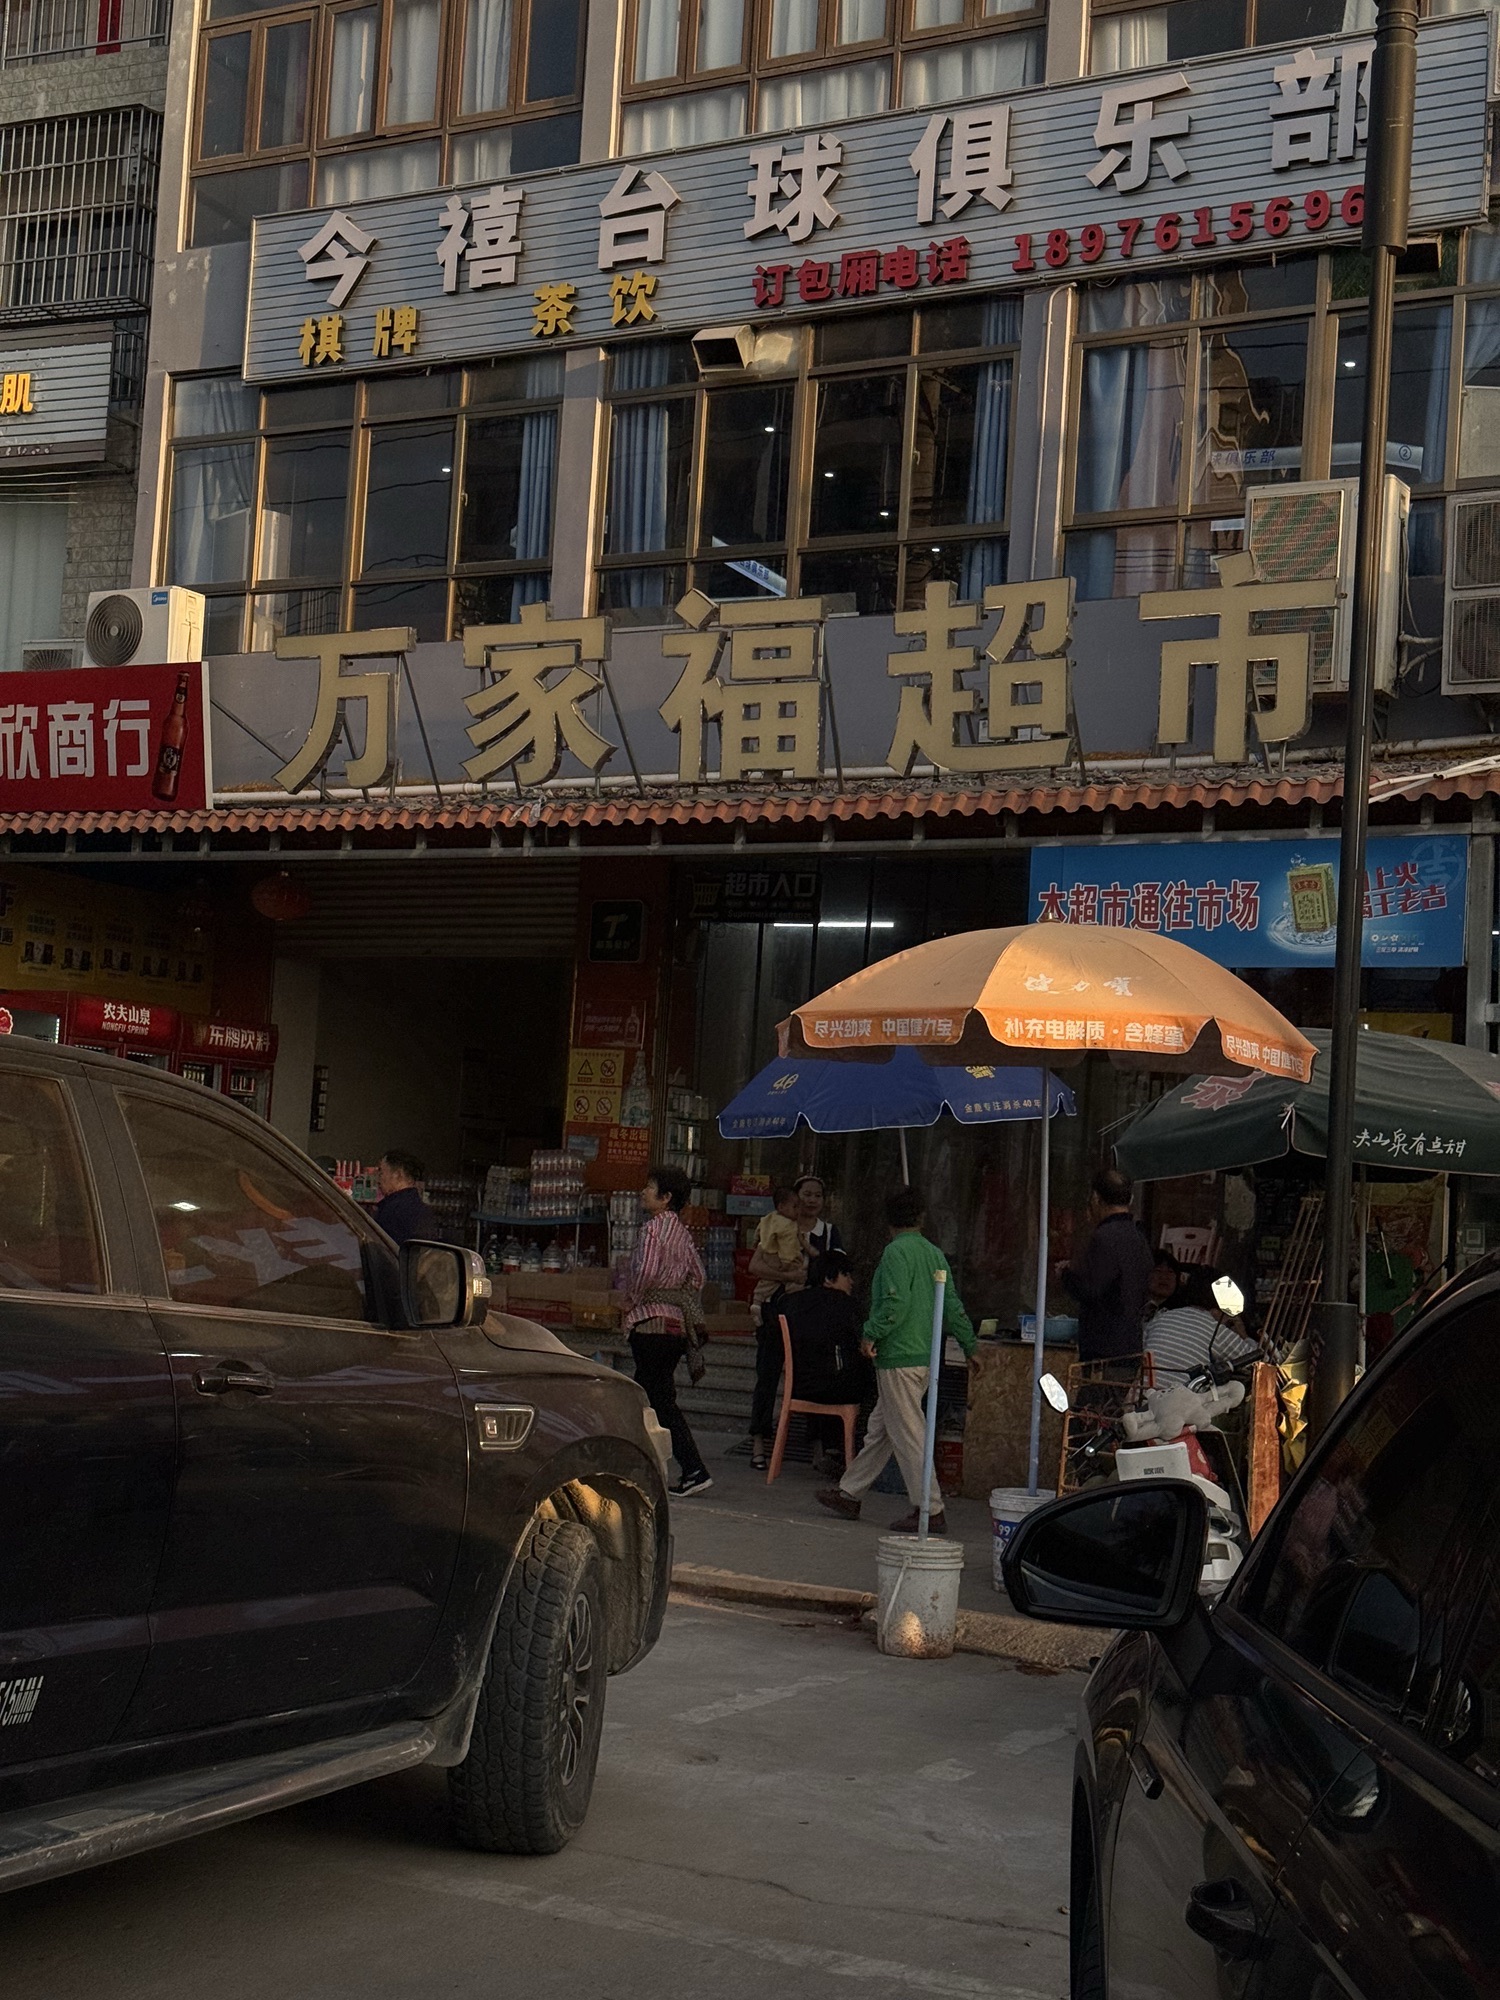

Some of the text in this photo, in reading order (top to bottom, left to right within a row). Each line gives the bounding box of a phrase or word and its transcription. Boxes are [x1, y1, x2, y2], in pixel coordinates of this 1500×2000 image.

[297, 46, 1372, 308] 今禧台球俱乐部
[752, 236, 971, 307] 订包厢电话
[299, 270, 659, 368] 棋牌 茶饮
[0, 373, 33, 415] 肌
[271, 549, 1340, 796] 万家福超市
[725, 871, 817, 898] 超市入口
[1362, 861, 1418, 894] 上火
[101, 1021, 150, 1036] NONGFU SPRING
[103, 1002, 151, 1026] 农夫山泉
[814, 1017, 953, 1039] 尽兴劲爽 中国健力宝
[208, 1024, 271, 1053] 东鹏饮料
[1352, 1128, 1467, 1159] 夫山泉有点甜
